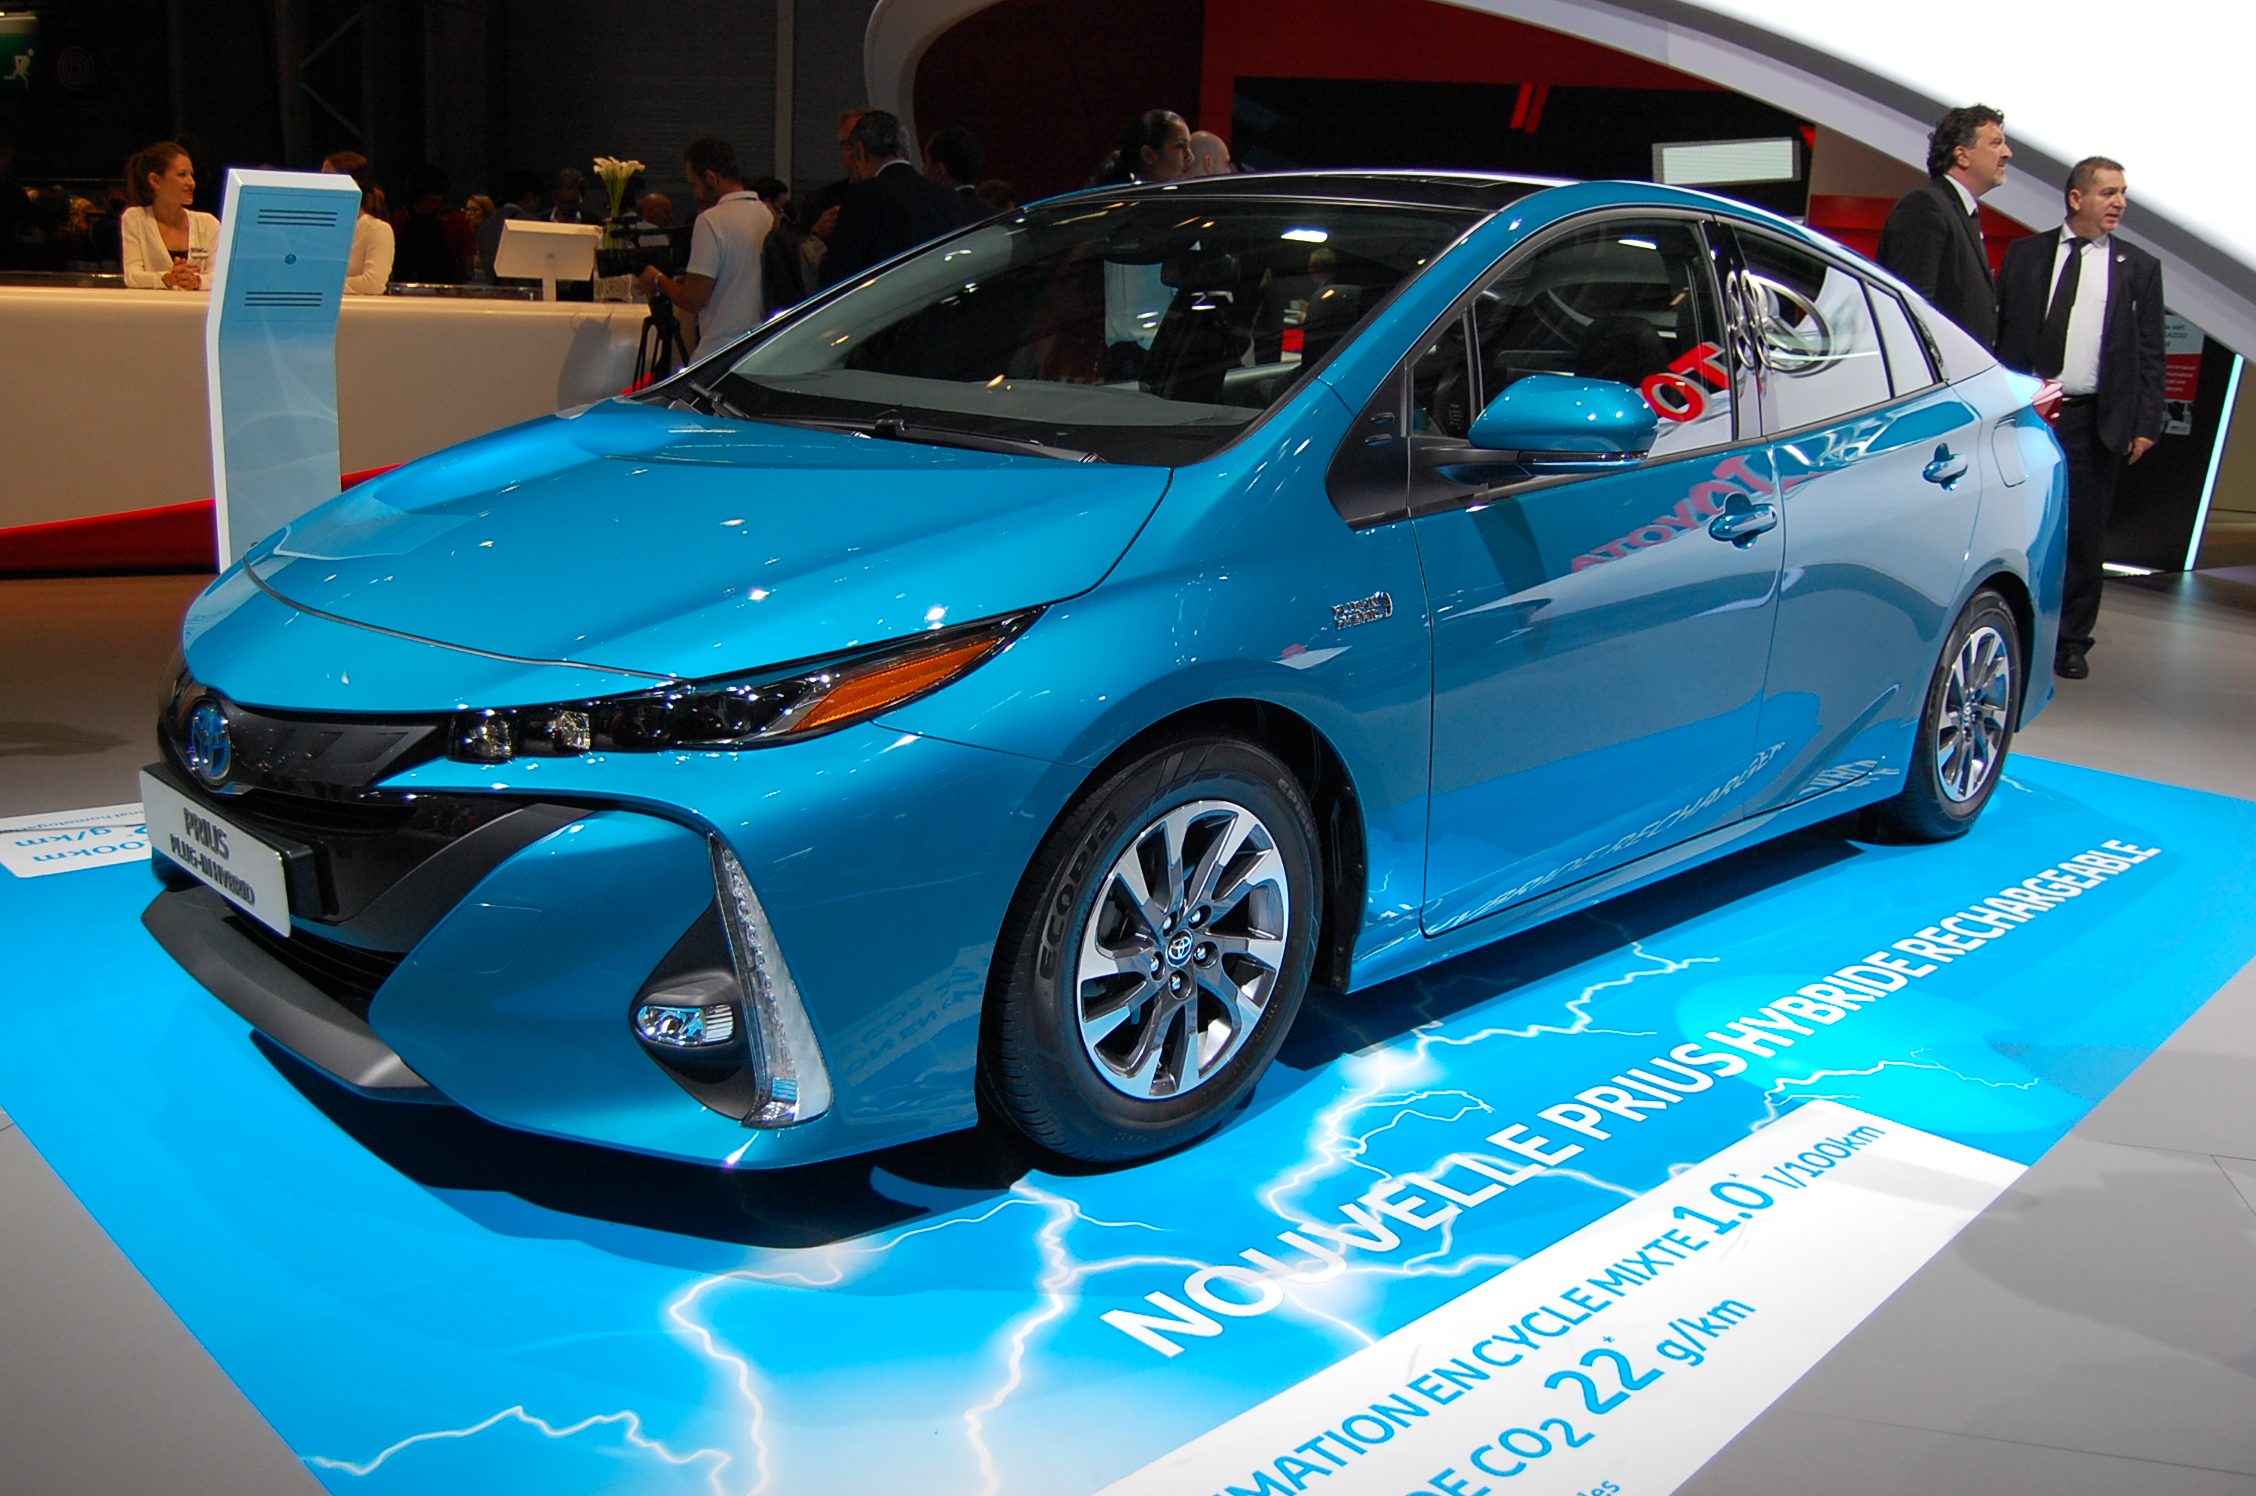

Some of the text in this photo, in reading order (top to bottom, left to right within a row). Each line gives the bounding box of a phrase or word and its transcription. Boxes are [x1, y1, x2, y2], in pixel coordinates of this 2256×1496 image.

[169, 833, 256, 907] PLUG-IN HYBRID
[183, 806, 230, 862] PRIUS
[1039, 809, 1118, 980] ECOPIA
[1100, 839, 2162, 1358] NOUVELLE PRIUS HYBRIDE RECHARGEABLE
[1211, 1393, 1431, 1496] MATION
[1407, 1358, 1491, 1406] EN
[1472, 1286, 1613, 1367] CYCLE
[1586, 1228, 1710, 1297] MIXTE
[1656, 1299, 1757, 1368] g/km
